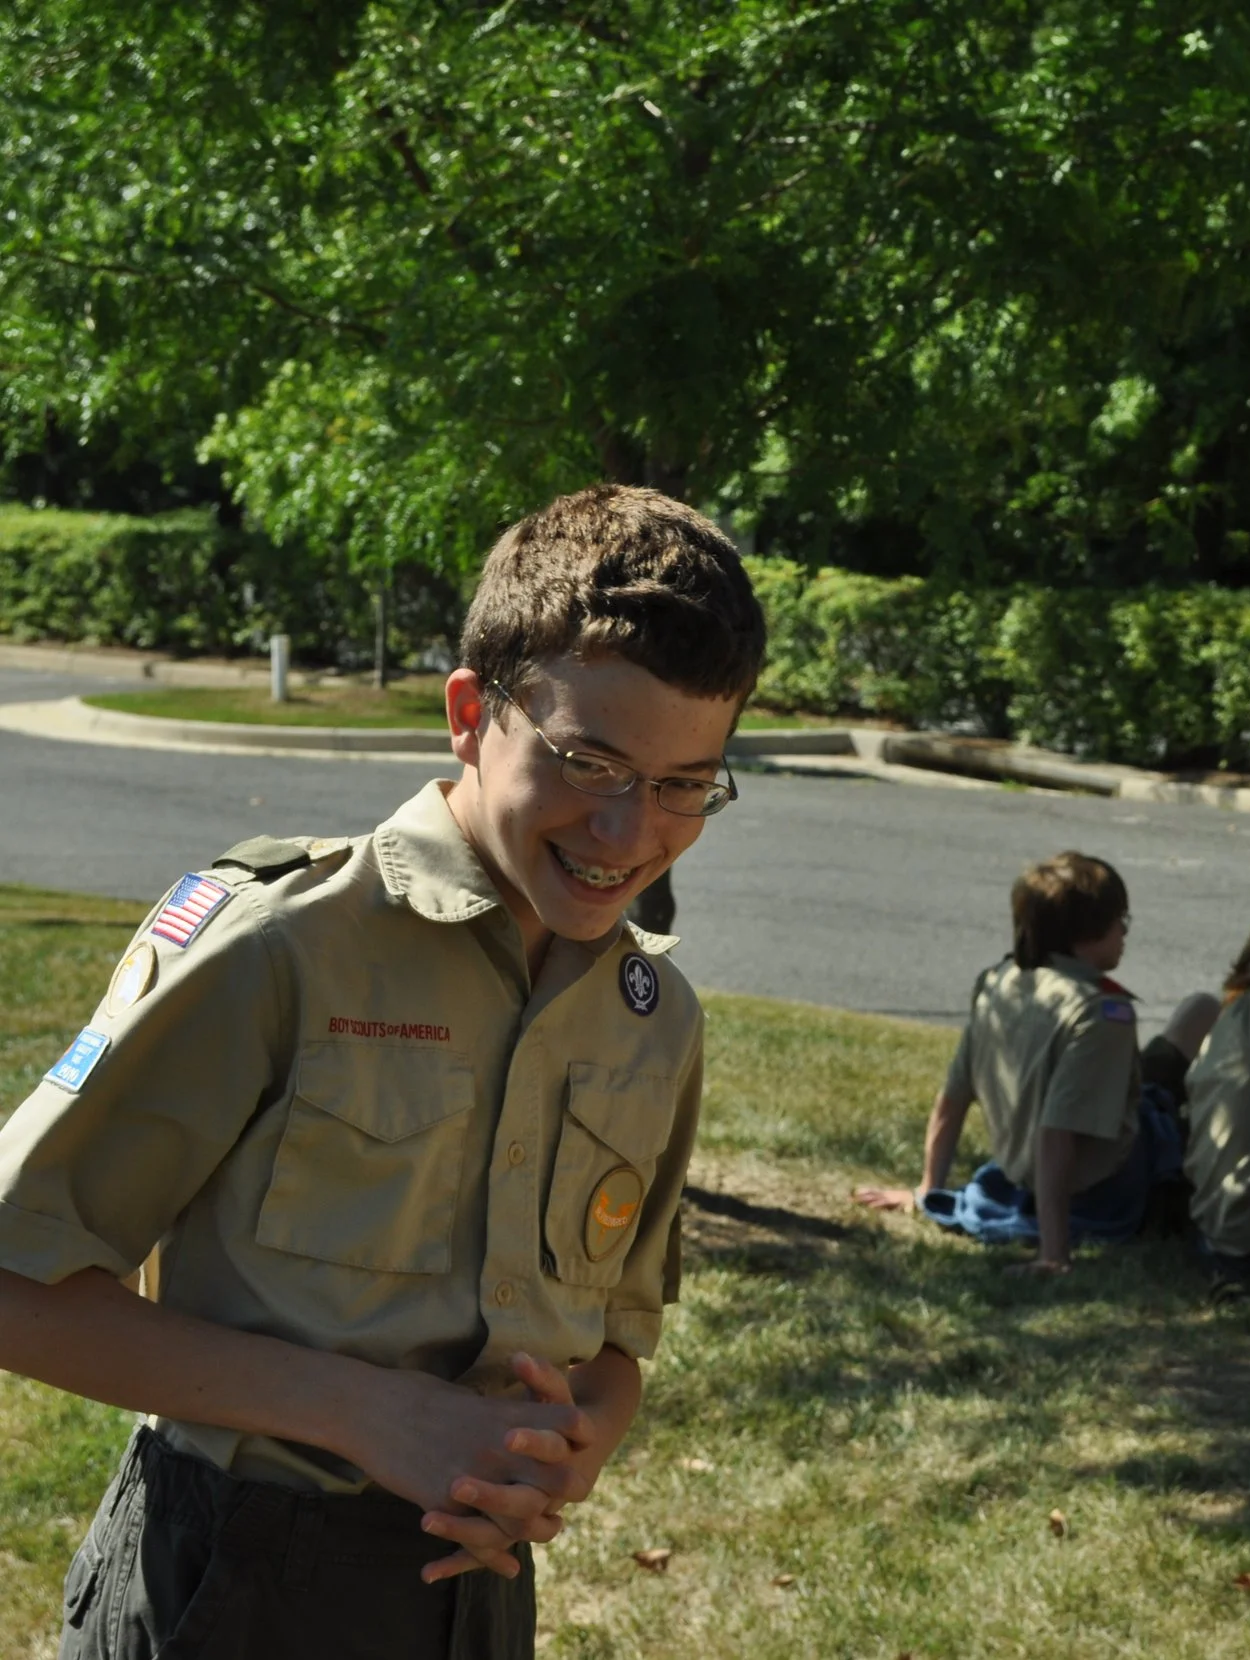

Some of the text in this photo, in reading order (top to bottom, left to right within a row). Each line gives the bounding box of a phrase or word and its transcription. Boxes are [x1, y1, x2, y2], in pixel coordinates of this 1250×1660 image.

[329, 1016, 349, 1033] BOY
[386, 1024, 400, 1036] OF
[400, 1023, 450, 1042] AMERICA
